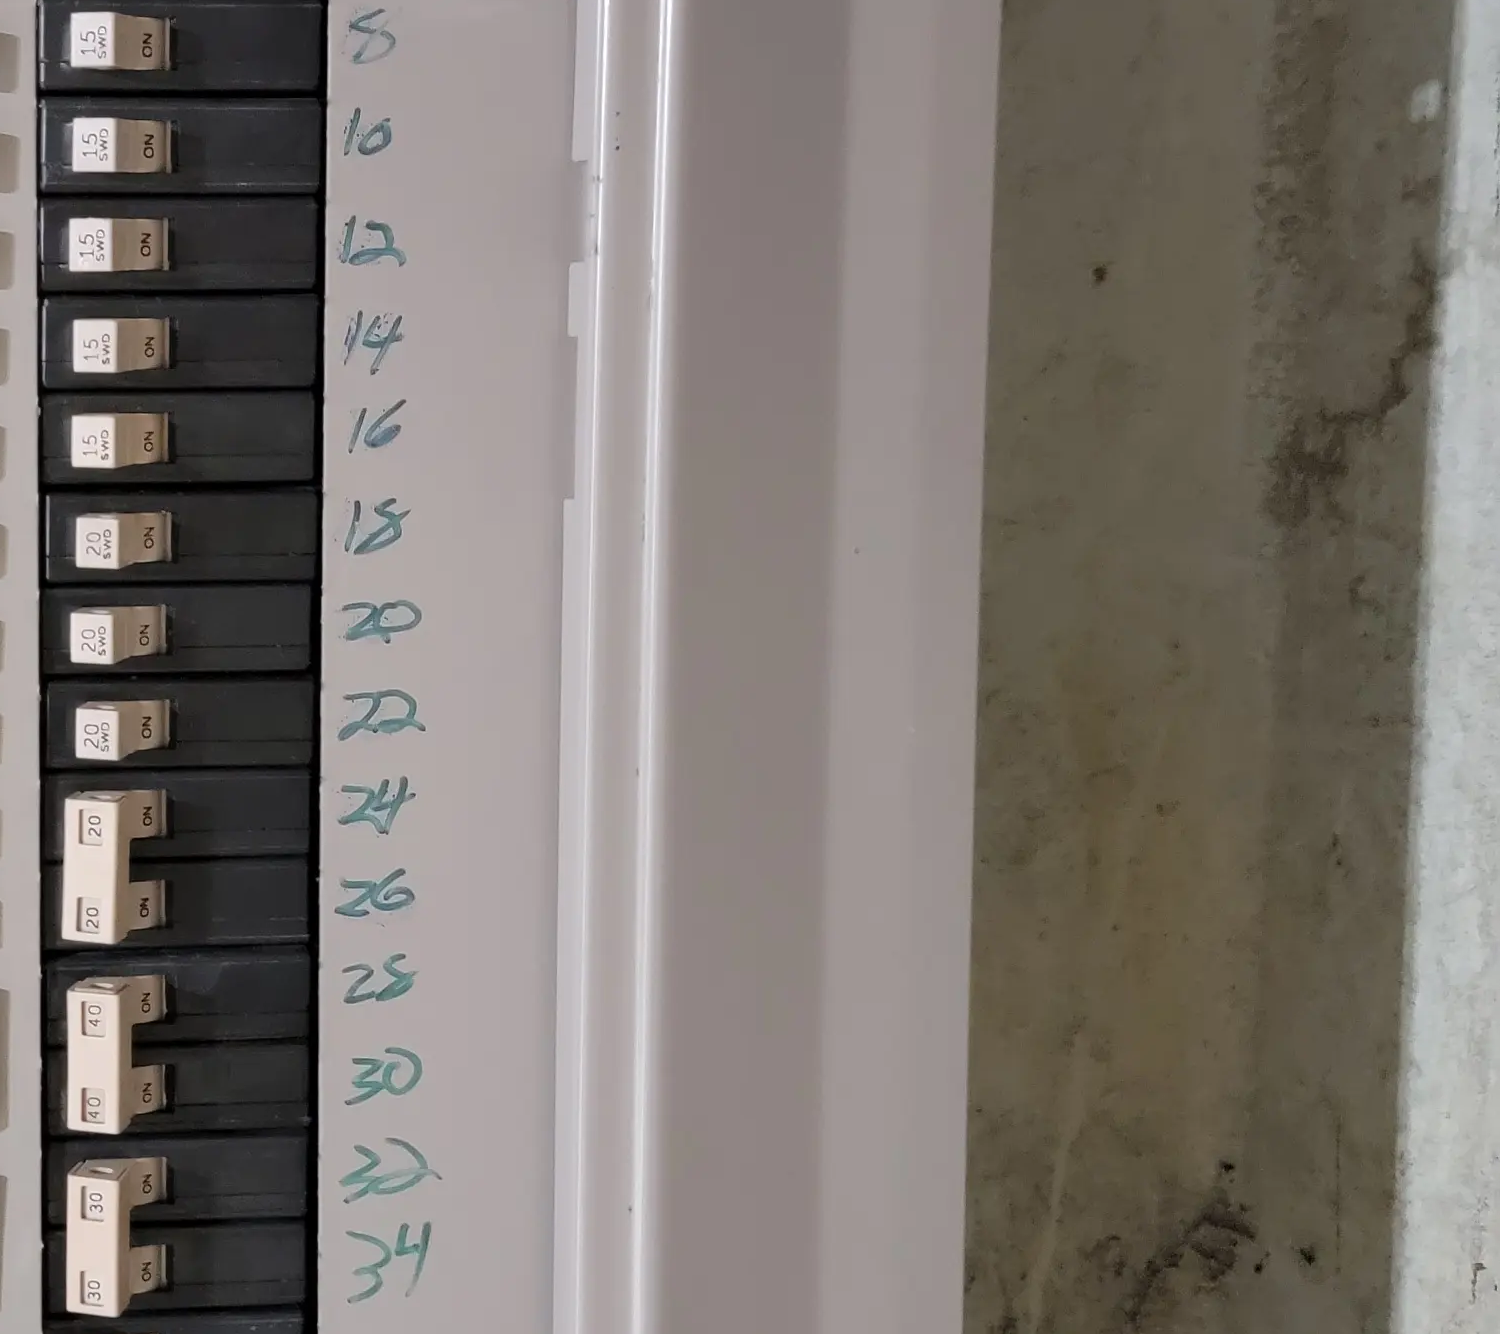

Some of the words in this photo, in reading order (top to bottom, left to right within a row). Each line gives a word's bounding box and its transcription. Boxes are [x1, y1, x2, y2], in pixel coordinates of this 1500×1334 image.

[349, 9, 396, 63] 8
[343, 108, 391, 156] 10
[340, 215, 406, 266] 12
[343, 310, 405, 376] 14
[82, 434, 97, 458] 15
[100, 429, 110, 461] SWD
[143, 431, 154, 452] ON
[348, 399, 406, 454] 16
[343, 498, 411, 555] 18
[340, 599, 422, 644] 20
[334, 868, 416, 917] 26
[86, 907, 99, 929] 20
[342, 953, 418, 1005] 28
[88, 1005, 102, 1027] 40
[345, 1047, 422, 1105] 30
[90, 1192, 102, 1213] 30
[346, 1222, 432, 1303] 34
